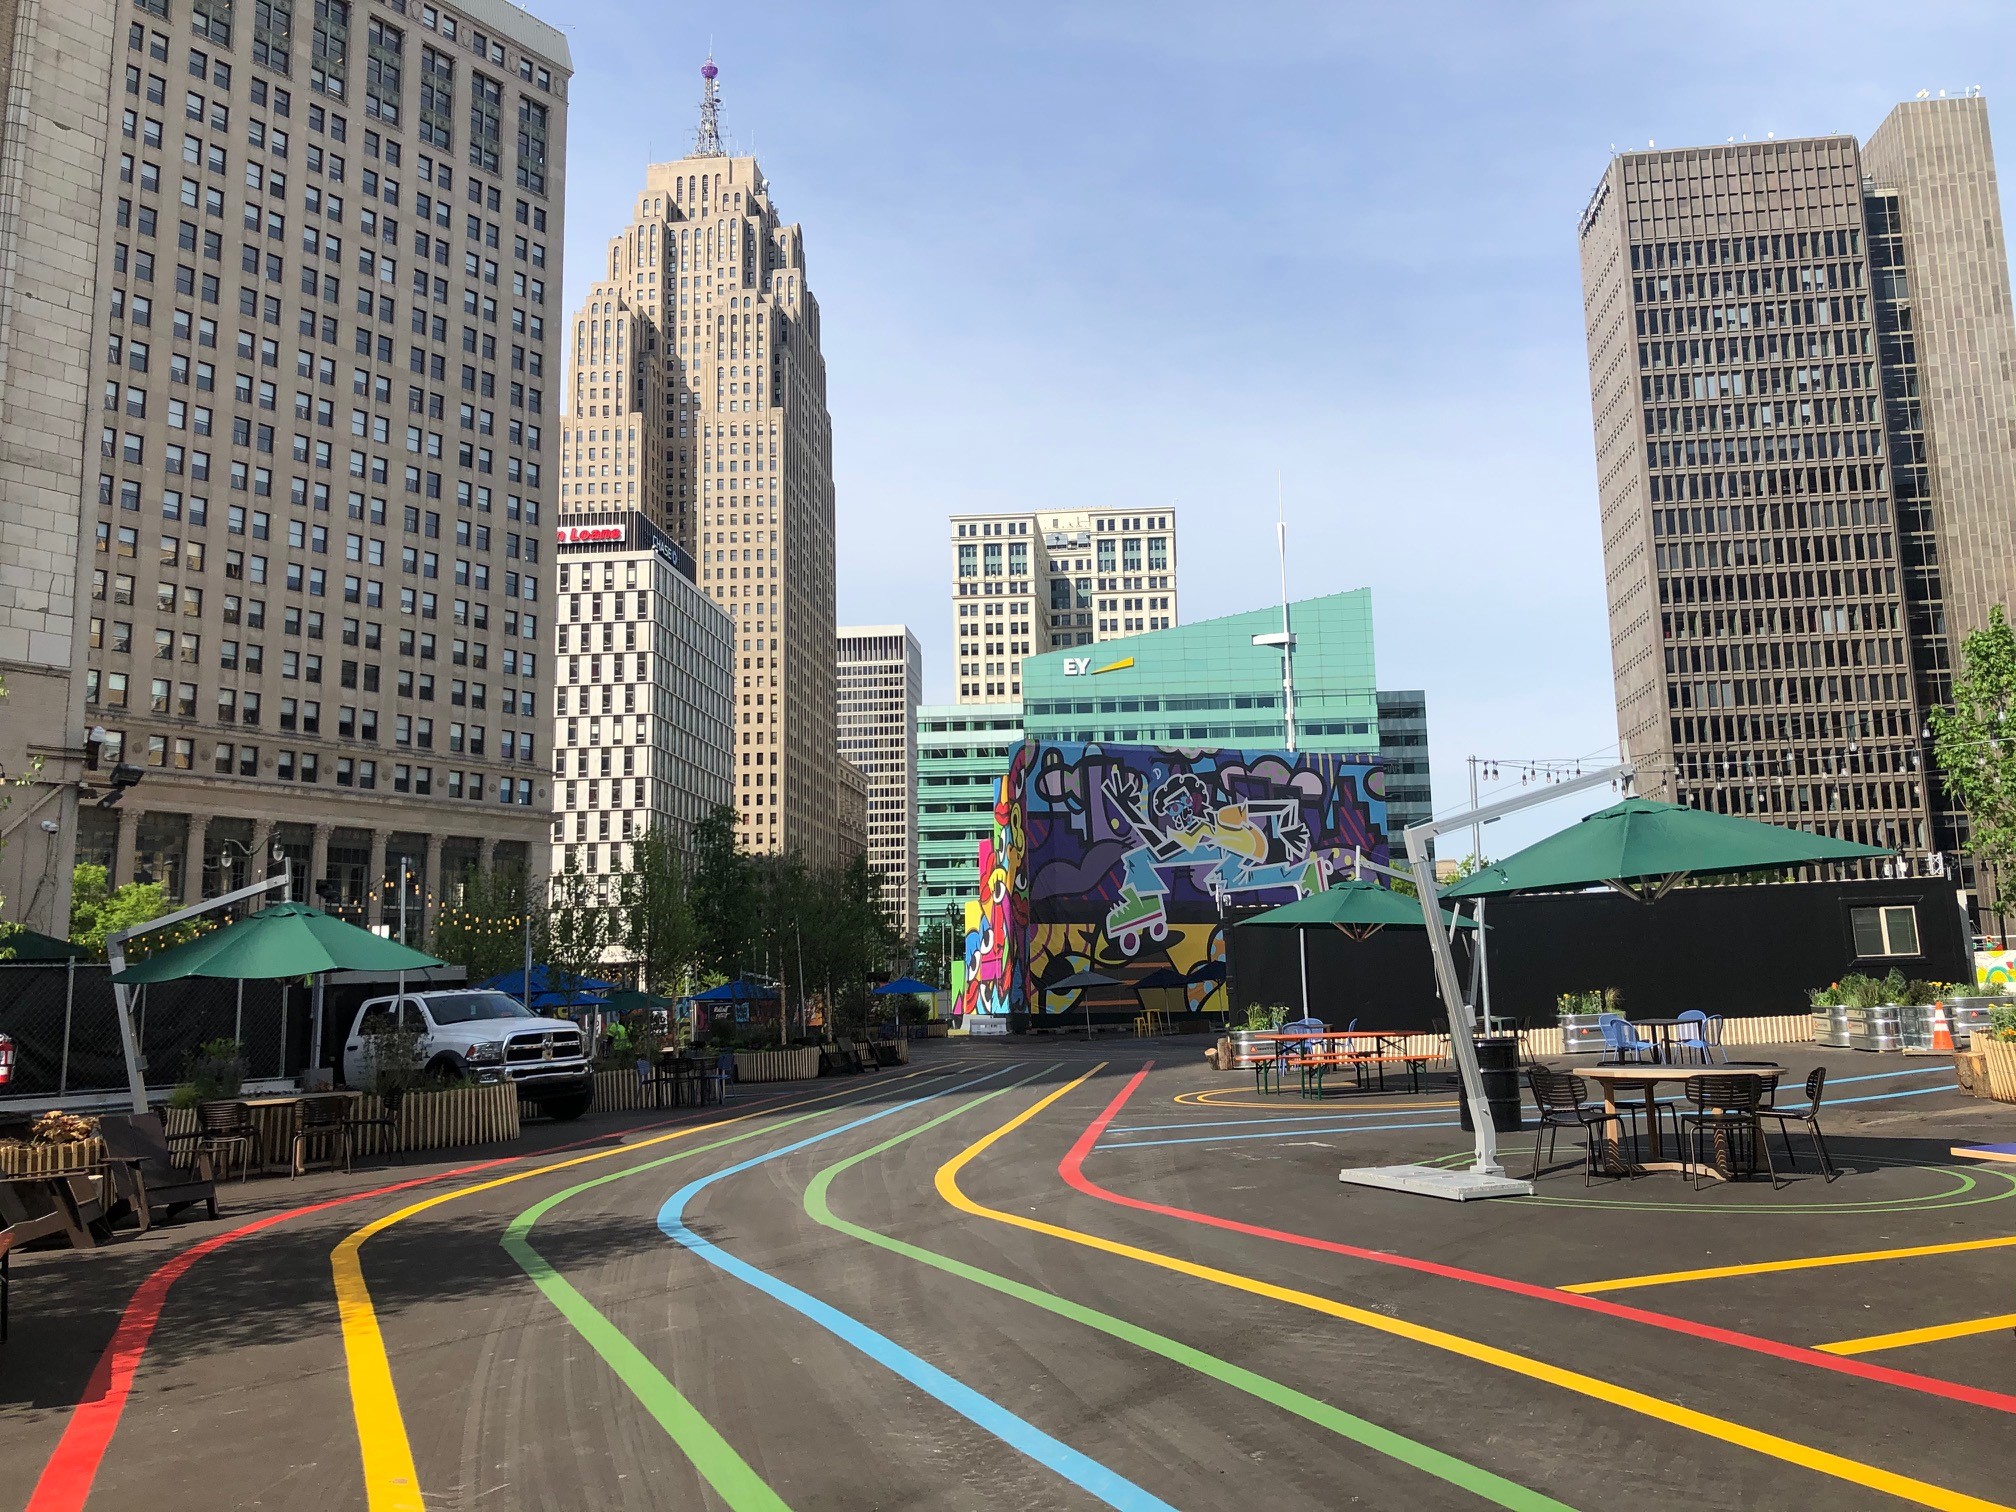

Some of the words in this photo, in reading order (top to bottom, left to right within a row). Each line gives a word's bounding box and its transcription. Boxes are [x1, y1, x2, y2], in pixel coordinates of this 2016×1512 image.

[570, 527, 622, 542] Loans
[652, 535, 672, 560] CHASE
[1063, 657, 1091, 675] EY
